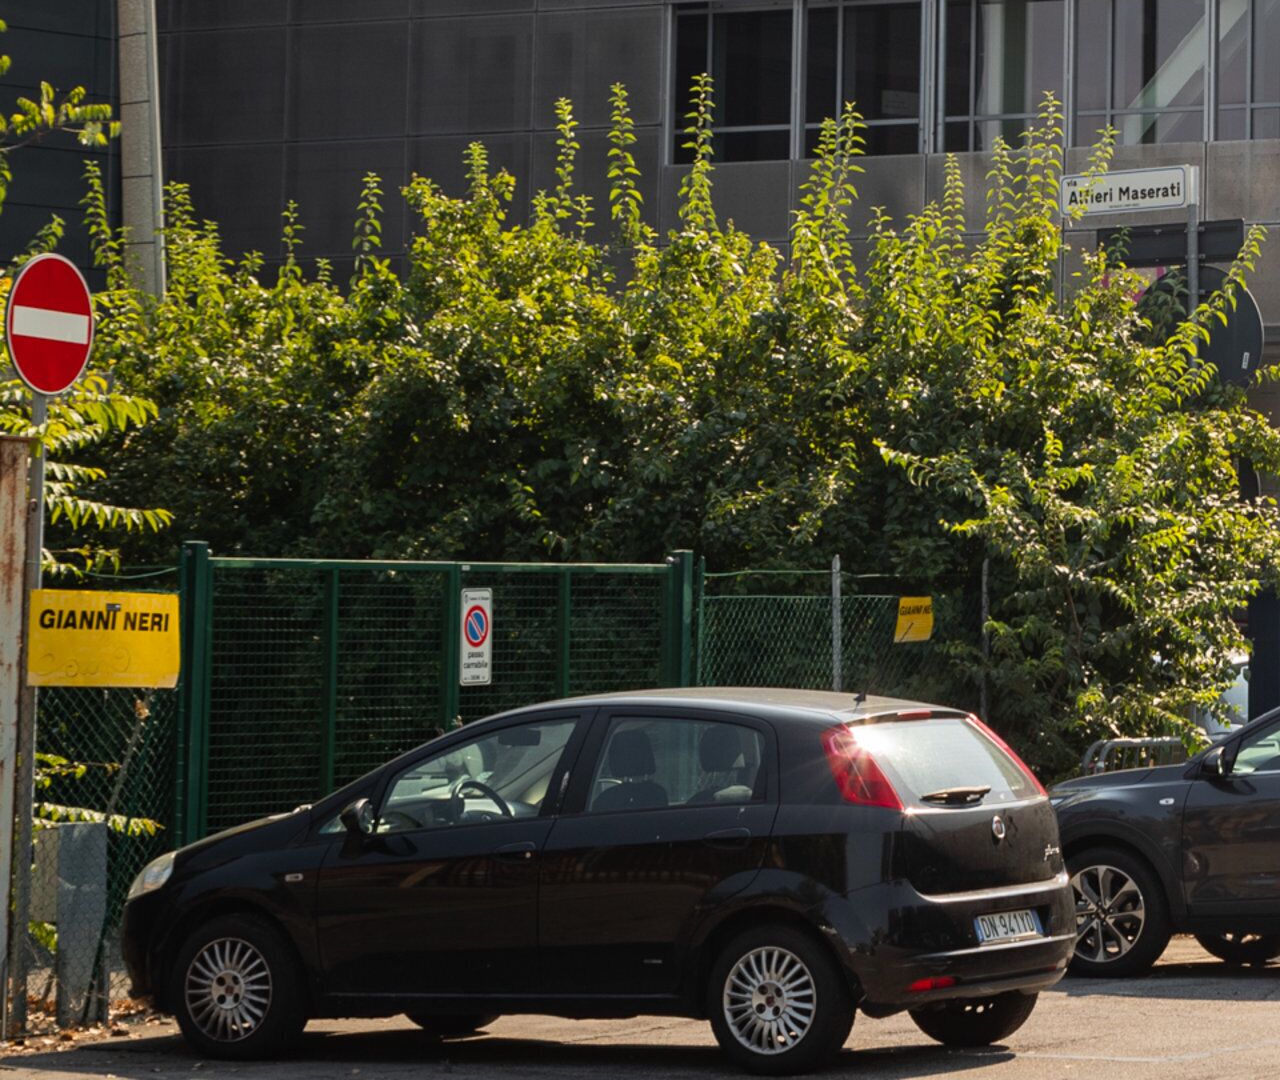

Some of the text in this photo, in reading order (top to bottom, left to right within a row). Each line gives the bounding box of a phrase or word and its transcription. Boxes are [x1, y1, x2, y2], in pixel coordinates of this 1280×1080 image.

[1118, 182, 1181, 201] Maserati
[39, 608, 170, 632] GIANNI NERI
[981, 917, 1000, 938] DN
